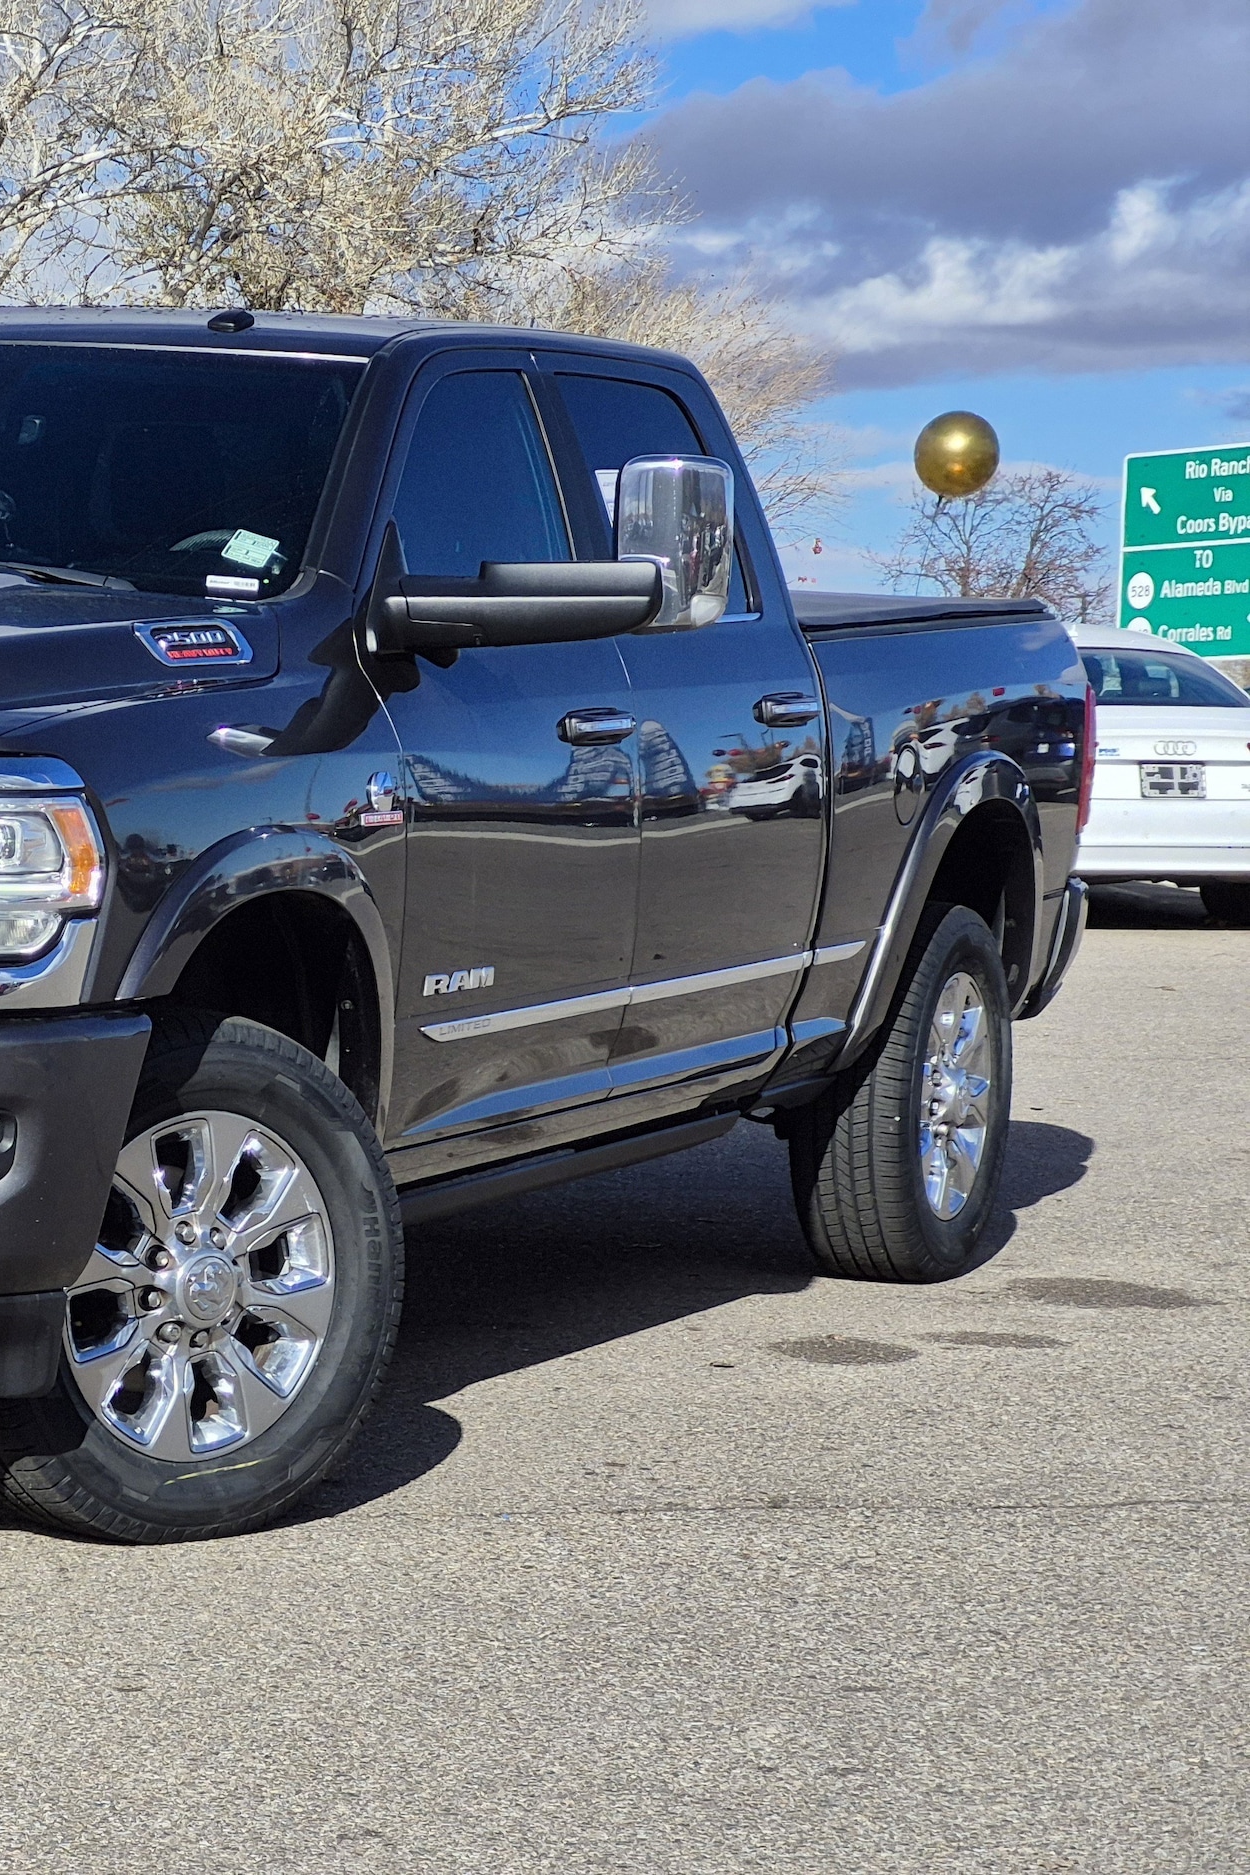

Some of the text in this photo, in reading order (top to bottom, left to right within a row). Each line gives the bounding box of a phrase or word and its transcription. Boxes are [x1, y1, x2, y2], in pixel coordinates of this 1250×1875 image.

[1185, 460, 1208, 479] Rio
[1213, 486, 1233, 502] Via
[1177, 515, 1216, 534] Coors
[1193, 549, 1213, 568] TO
[1131, 585, 1150, 598] 528
[1160, 577, 1250, 598] Alameda Blvd
[154, 629, 226, 651] 2500
[1158, 623, 1214, 642] Corrales
[1216, 625, 1232, 640] Rd
[422, 966, 495, 997] RAM
[438, 1018, 491, 1037] LIMITED
